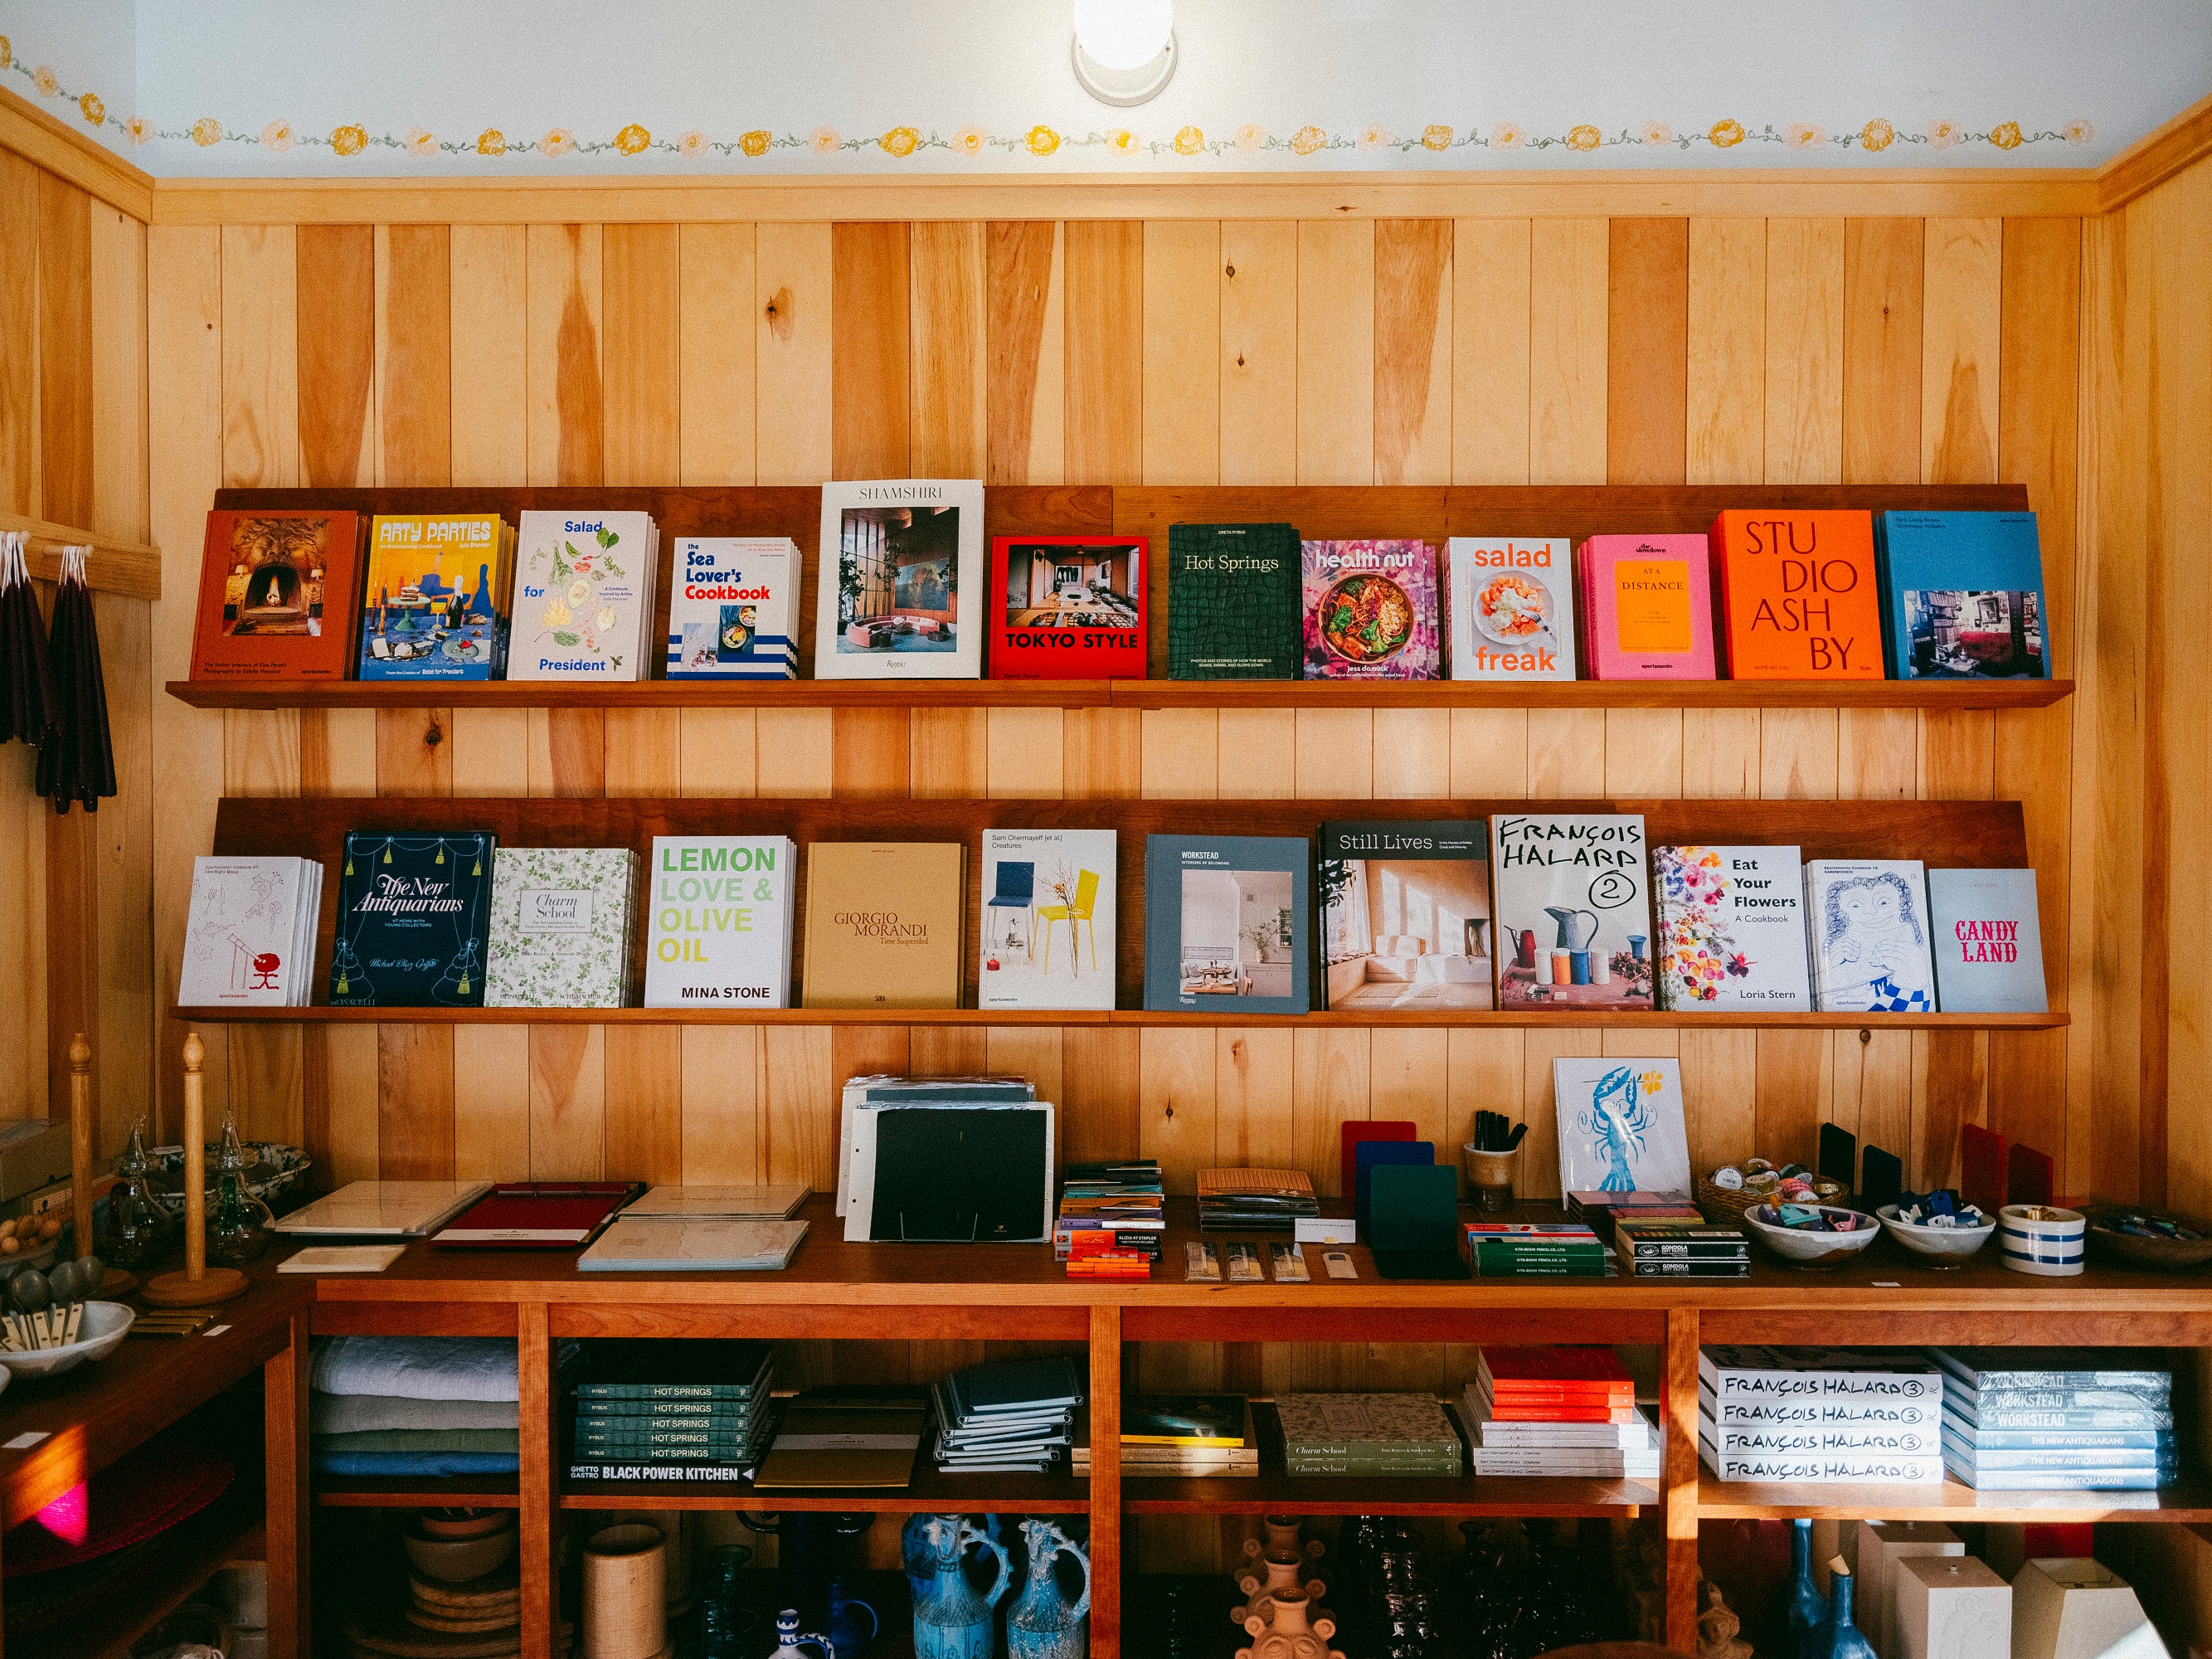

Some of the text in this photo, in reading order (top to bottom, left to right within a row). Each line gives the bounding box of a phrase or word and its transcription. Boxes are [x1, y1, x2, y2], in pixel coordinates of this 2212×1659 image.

[859, 487, 941, 499] SHAMSHIRI
[380, 522, 491, 542] ARTY PARTIES
[564, 521, 602, 533] Salad
[1746, 521, 1816, 555] STU
[688, 552, 714, 566] Sea
[1316, 549, 1380, 568] health
[1383, 552, 1414, 567] nut
[1474, 543, 1551, 567] salad
[1184, 555, 1279, 572] Hot Springs
[686, 568, 741, 582] Lover's
[1782, 559, 1858, 593] DIO
[524, 586, 544, 597] for
[685, 585, 771, 600] Cookbook
[1622, 581, 1683, 590] DISTANCE
[1751, 598, 1831, 632] ASH
[1005, 634, 1138, 648] TOKYO STYLE
[1475, 646, 1556, 671] freak
[1811, 636, 1854, 670] BY
[539, 659, 605, 672] President
[1500, 818, 1641, 849] FRANÇOIS
[1339, 834, 1432, 849] Still Lives
[664, 848, 775, 871] LEMON
[1181, 851, 1219, 859] WORKSTEAD
[1503, 844, 1638, 868] HALARD
[1733, 859, 1758, 870] Eat
[377, 873, 450, 898] The New
[663, 878, 774, 902] LOVE &
[1733, 878, 1772, 889] Your
[352, 892, 464, 916] Antiquarians
[537, 894, 577, 906] Charm
[1734, 896, 1796, 908] Flowers
[537, 907, 576, 918] School
[659, 907, 753, 932] OLIVE
[834, 912, 897, 924] GIORGIO
[1744, 914, 1789, 923] Cookbook
[854, 924, 926, 936] MORANDI
[1955, 921, 2018, 941] CANDY
[897, 937, 928, 946] Suspended
[657, 938, 708, 962] OIL
[1961, 942, 2017, 962] LAND
[370, 959, 396, 967] Michael
[682, 987, 771, 998] MINA STONE
[1740, 990, 1796, 999] Loria Stern
[654, 1388, 672, 1396] HOT
[673, 1388, 712, 1396] SPRINGS
[1725, 1378, 1819, 1397] FRANÇOIS
[1824, 1379, 1901, 1394] HALARD
[1995, 1394, 2063, 1408] WORKSTEAD
[654, 1404, 672, 1413] HOT
[673, 1404, 712, 1413] SPRINGS
[1724, 1406, 1817, 1424] FRANÇOIS
[1822, 1406, 1899, 1422] HALARD
[653, 1420, 670, 1428] HOT
[672, 1420, 710, 1428] SPRINGS
[1997, 1413, 2065, 1427] WORKSTEAD
[651, 1434, 668, 1443] HOT
[670, 1434, 708, 1443] SPRINGS
[1726, 1434, 1817, 1452] FRANÇOIS
[1823, 1434, 1898, 1449] HALARD
[651, 1450, 668, 1458] HOT
[670, 1450, 709, 1458] SPRINGS
[1296, 1447, 1347, 1455] Charm School
[603, 1467, 738, 1481] BLACK POWER KITCHEN
[1726, 1462, 1820, 1480] FRANÇOIS
[1825, 1462, 1901, 1478] HALARD
